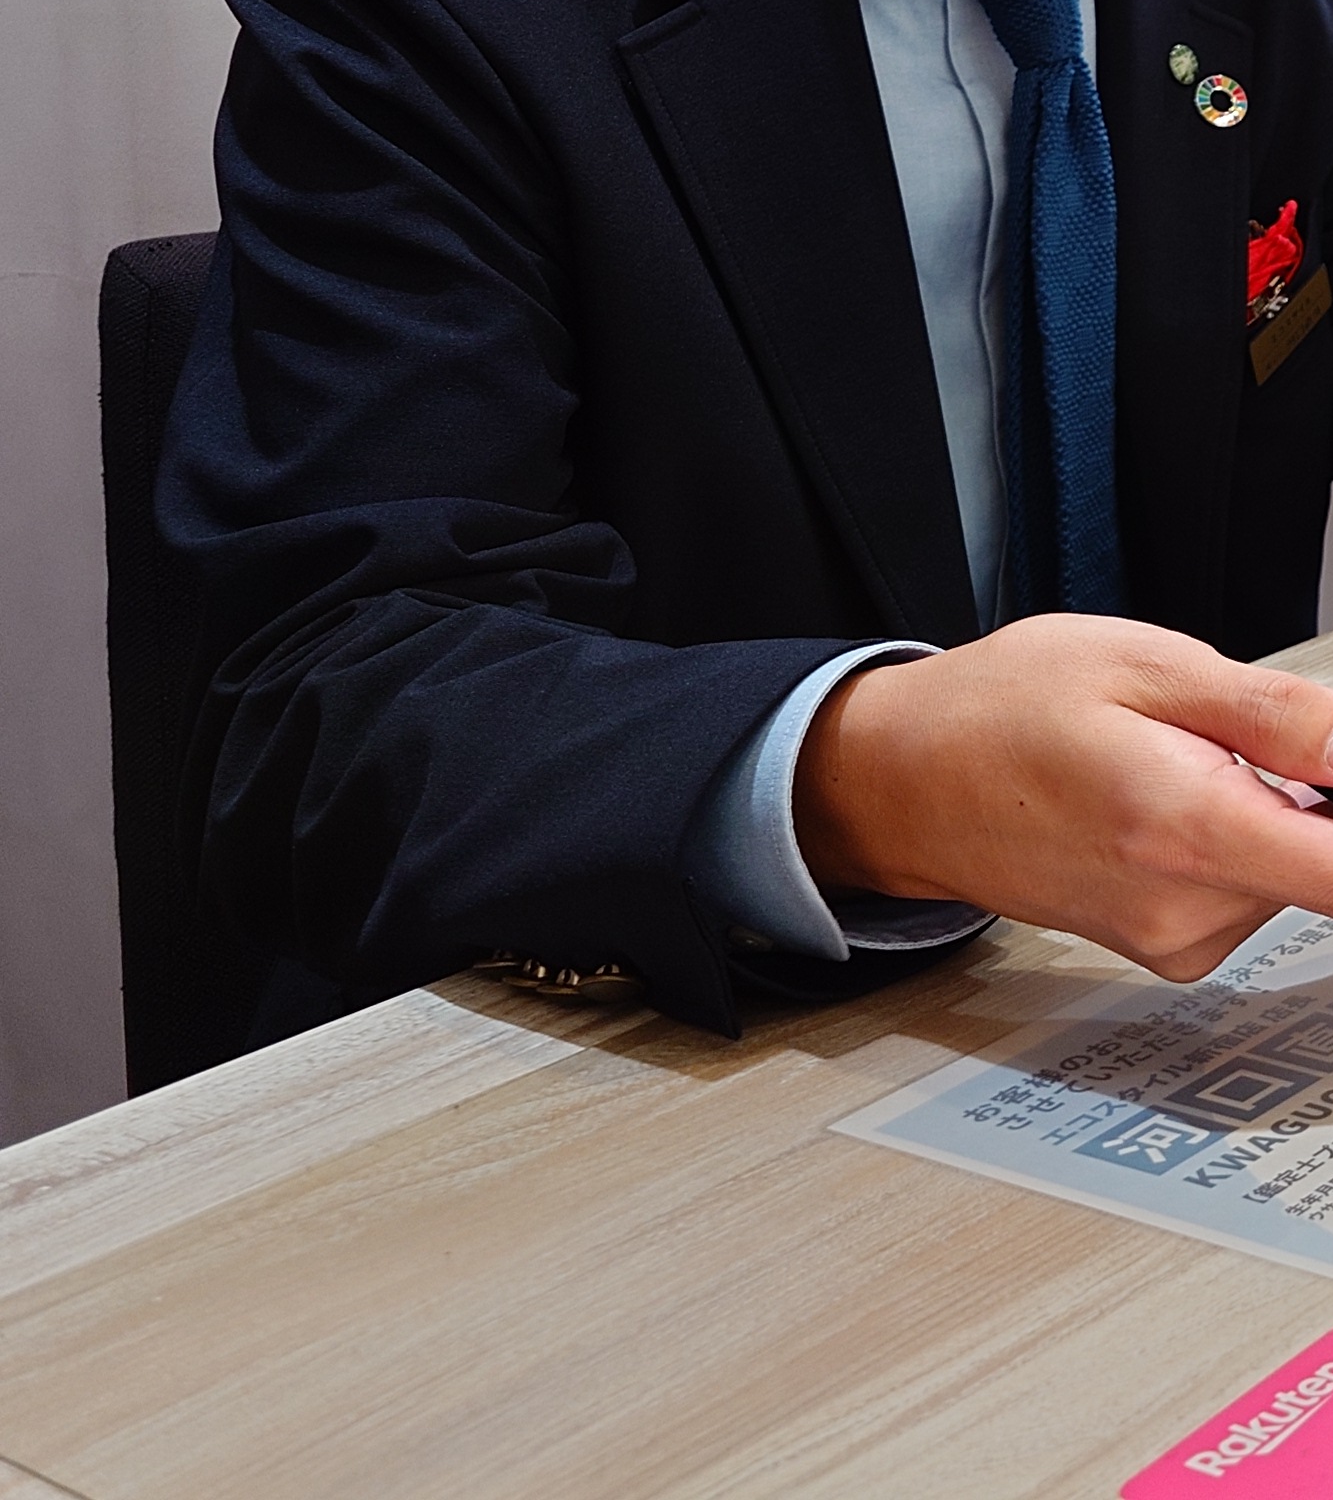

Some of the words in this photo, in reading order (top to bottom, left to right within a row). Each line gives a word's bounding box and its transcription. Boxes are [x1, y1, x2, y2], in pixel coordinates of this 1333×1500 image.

[993, 983, 1269, 1133] させていただきます！
